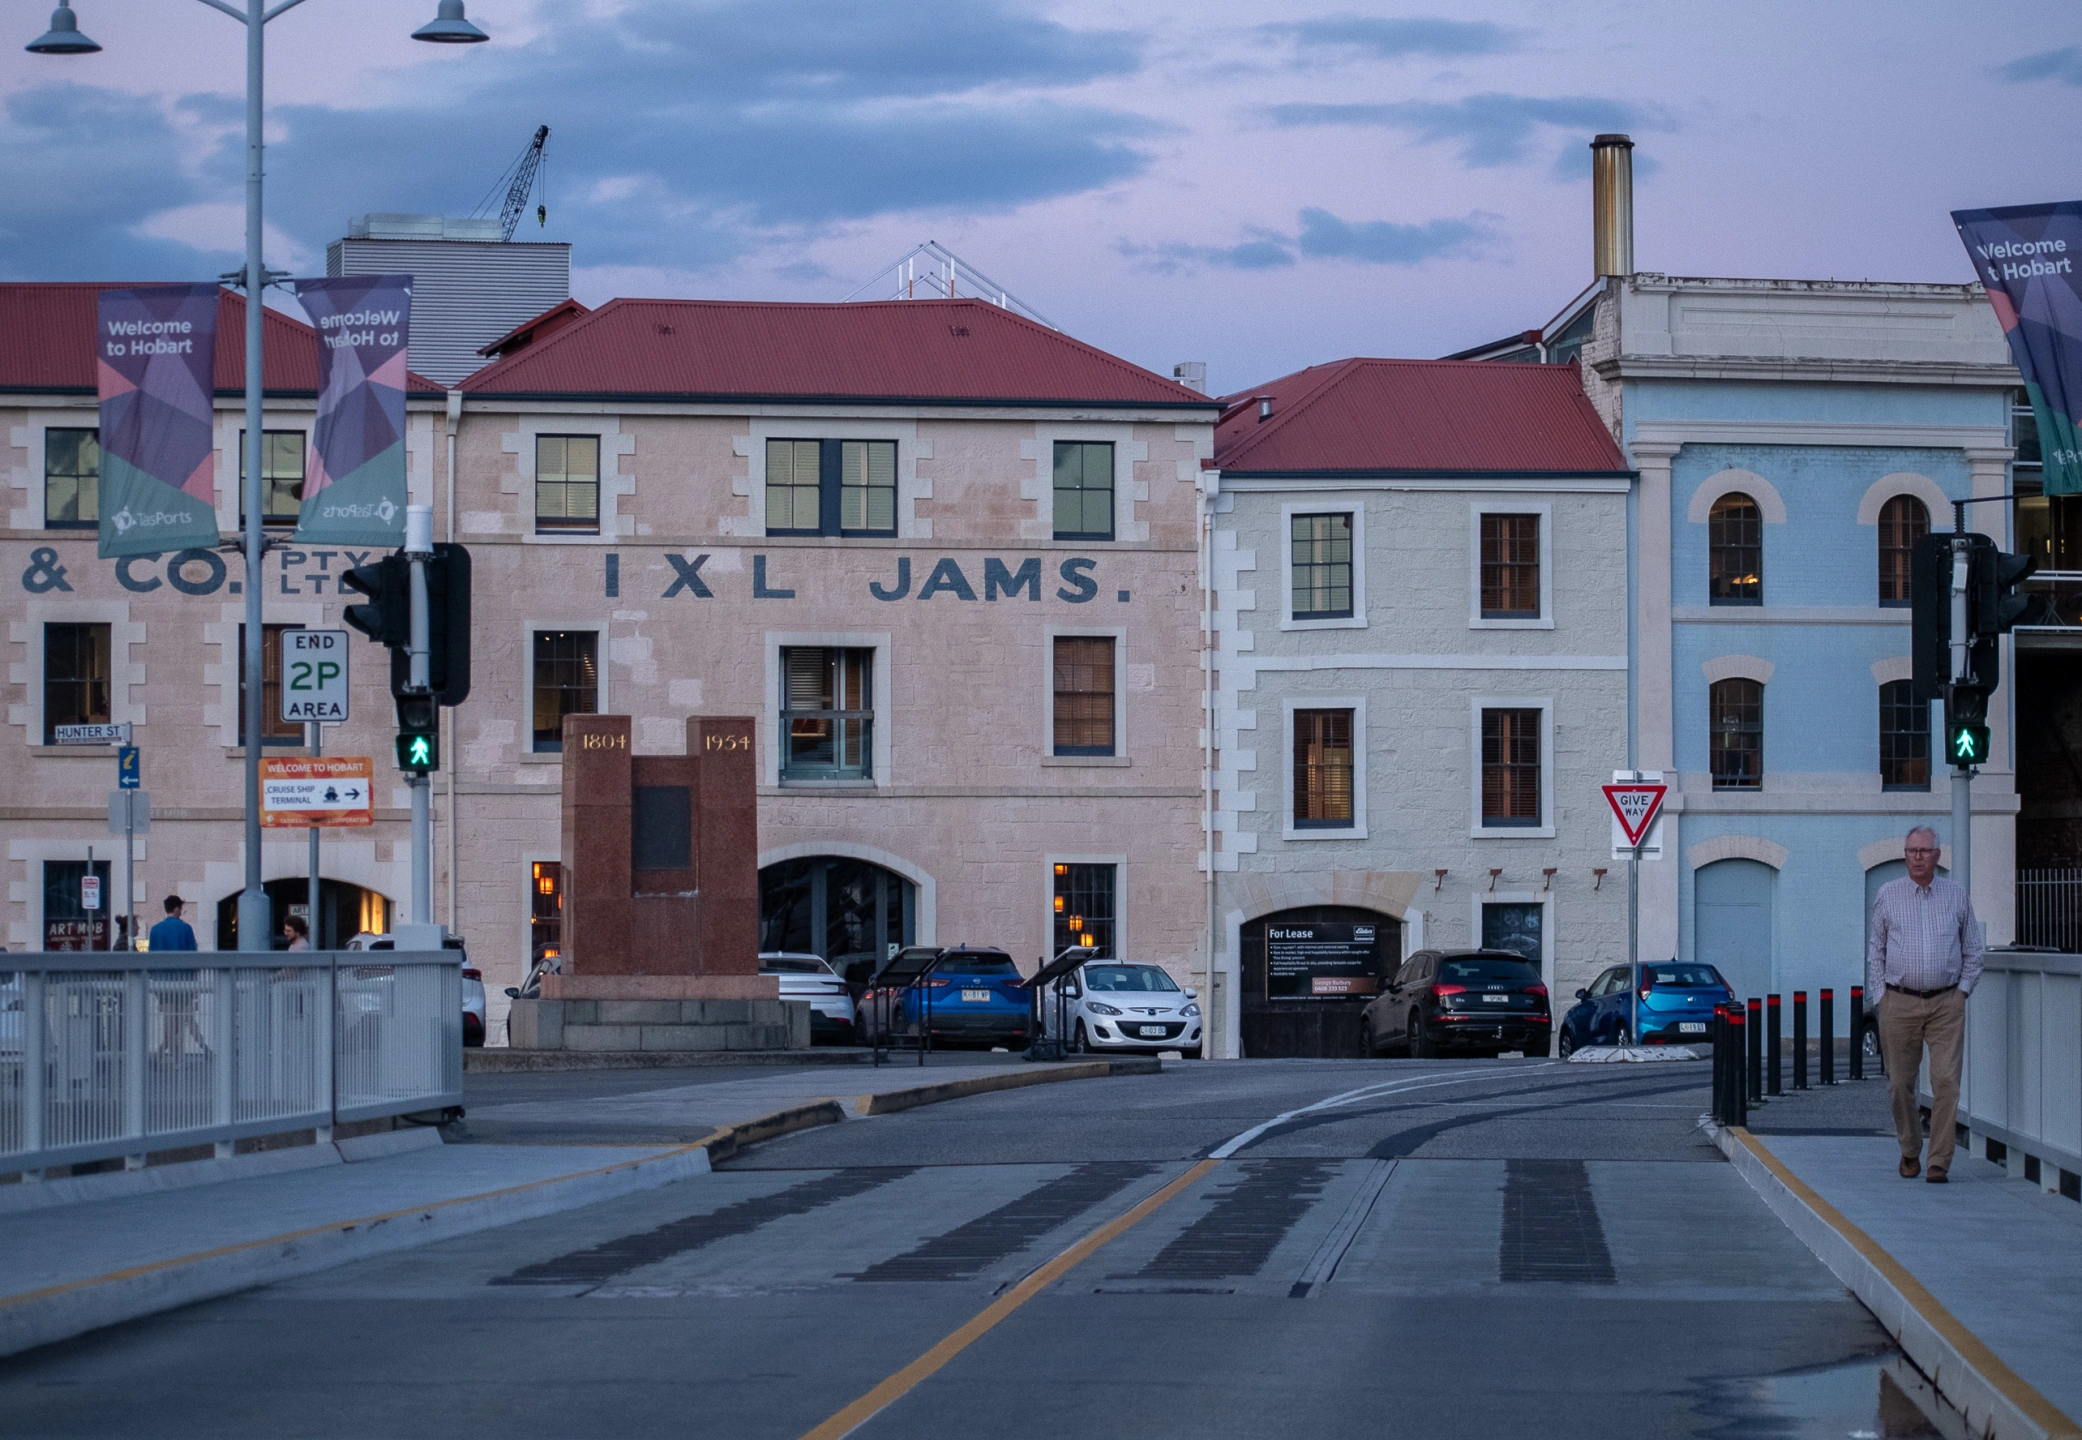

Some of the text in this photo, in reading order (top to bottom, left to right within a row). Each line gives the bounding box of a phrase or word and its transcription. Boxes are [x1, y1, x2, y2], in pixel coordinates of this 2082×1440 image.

[1976, 240, 2067, 260] Welcome
[1987, 257, 2072, 281] t Hobart
[107, 320, 192, 336] Welcome
[106, 338, 193, 356] to Hobart
[136, 511, 192, 527] TasPorts
[281, 551, 371, 571] PTY
[22, 547, 242, 596] & CO.
[605, 553, 1130, 603] I X L JAMS.
[296, 635, 334, 649] END
[290, 661, 340, 690] 2P
[289, 702, 342, 717] AREA
[57, 725, 120, 738] HUNTER ST
[583, 733, 626, 749] 1804
[706, 735, 750, 751] 1954
[267, 762, 364, 773] WELCOME TO HOBART
[267, 785, 315, 794] CRUISE SHIP
[271, 796, 312, 804] TERMINAL
[1620, 795, 1649, 806] GIVE
[1625, 808, 1645, 816] WAY
[293, 906, 307, 914] ART
[49, 922, 74, 935] ART
[1269, 929, 1313, 938] For Lease
